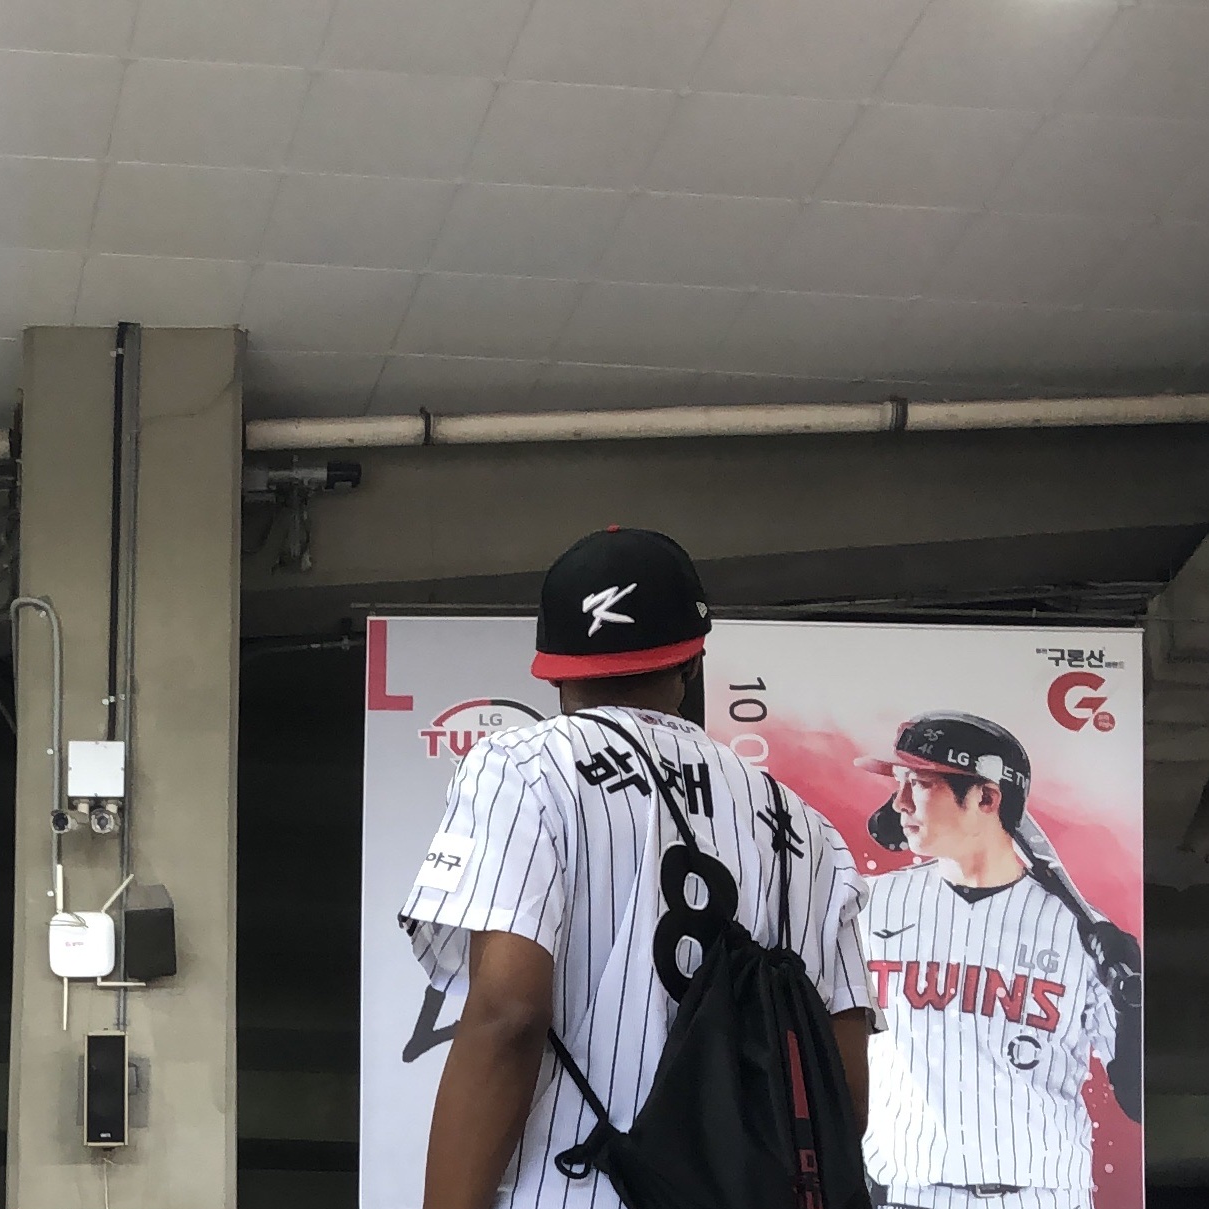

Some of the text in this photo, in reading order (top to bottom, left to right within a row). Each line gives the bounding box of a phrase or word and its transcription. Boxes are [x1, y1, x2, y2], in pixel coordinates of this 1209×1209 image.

[728, 676, 768, 722] 10
[479, 713, 503, 728] LG
[947, 748, 970, 767] LG
[1017, 943, 1061, 974] LG
[867, 959, 1066, 1034] TWINS
